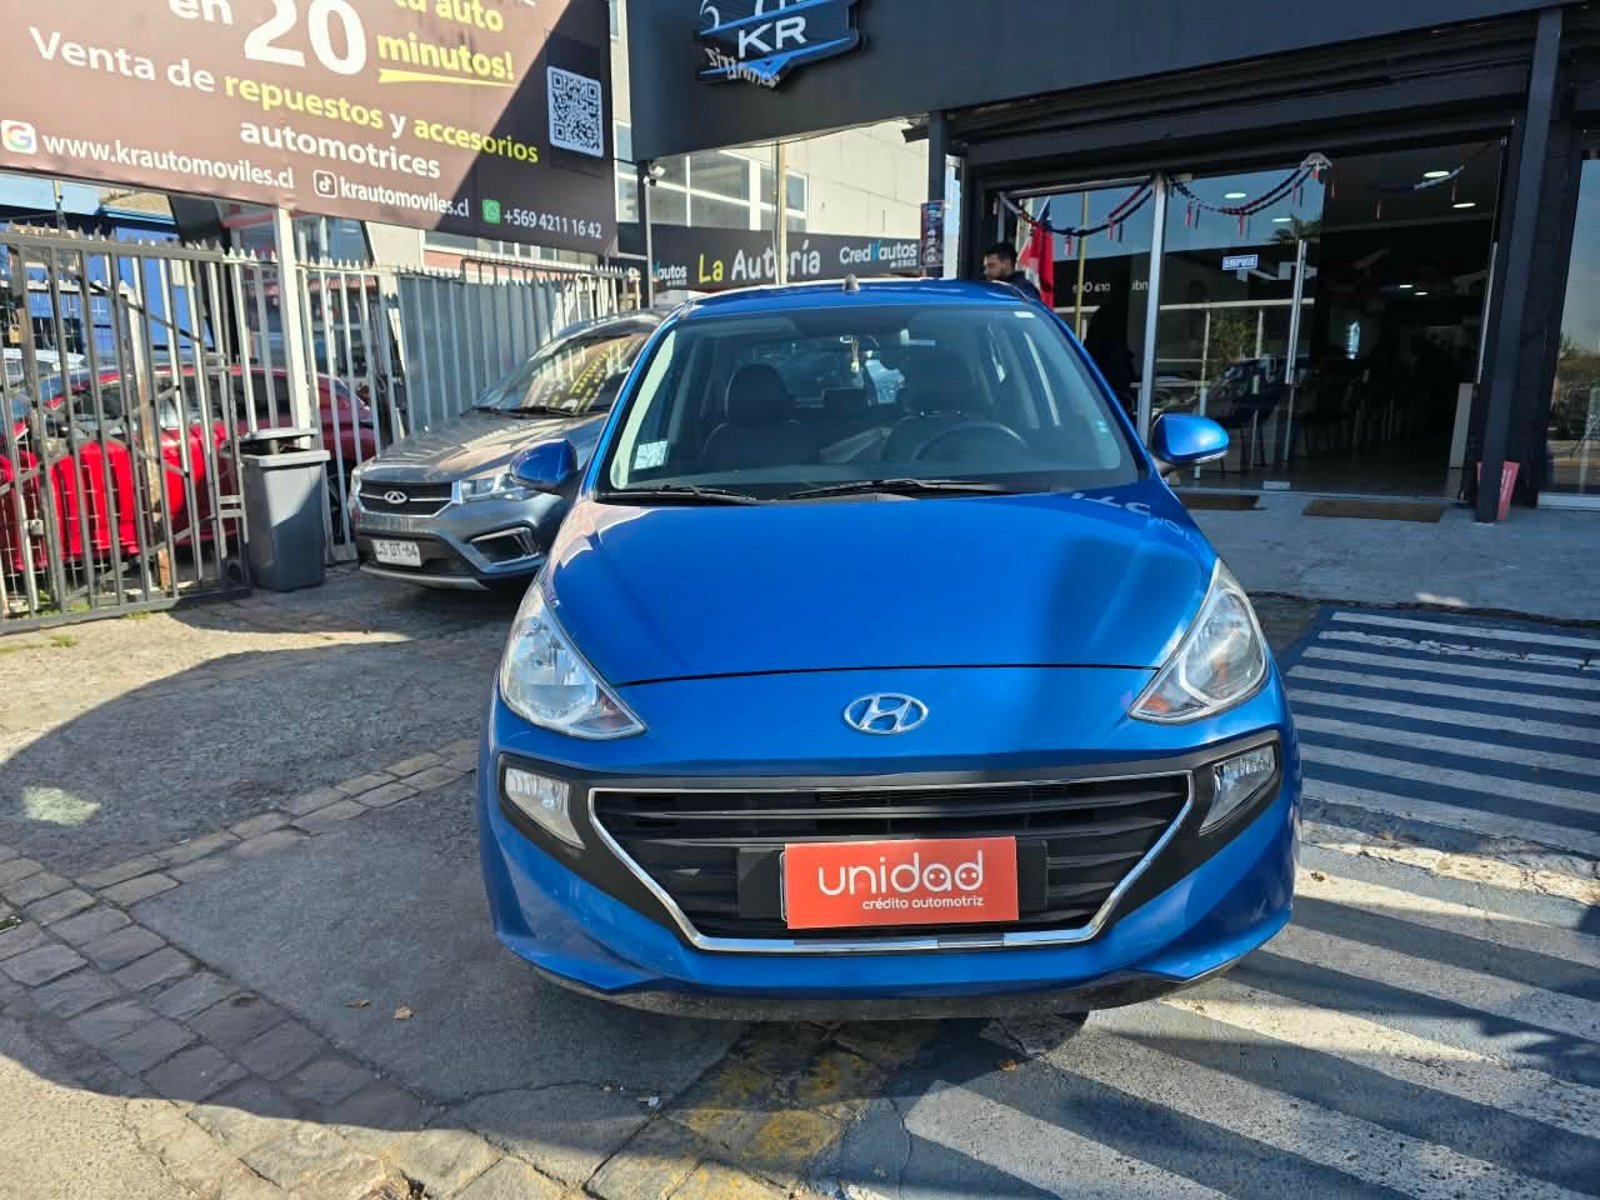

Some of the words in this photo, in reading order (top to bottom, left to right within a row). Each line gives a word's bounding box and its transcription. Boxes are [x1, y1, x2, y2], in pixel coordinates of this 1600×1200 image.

[435, 0, 504, 32] auto
[738, 16, 807, 58] KR
[244, 0, 366, 75] 20
[377, 31, 514, 80] minutos!
[29, 26, 156, 81] Venta
[166, 58, 215, 92] de
[225, 74, 384, 129] repuestos
[389, 112, 406, 139] y
[414, 118, 539, 163] accesorios
[42, 134, 294, 189] www.krautomoviles.cl
[240, 121, 440, 178] automotrices
[340, 177, 469, 218] krautomoviles.cl
[504, 208, 536, 228] +569
[539, 215, 568, 233] 4211
[699, 253, 724, 283] La
[730, 239, 821, 281] Autría
[818, 850, 983, 896] unidad
[862, 895, 906, 910] crédito
[912, 894, 984, 909] automotriz
